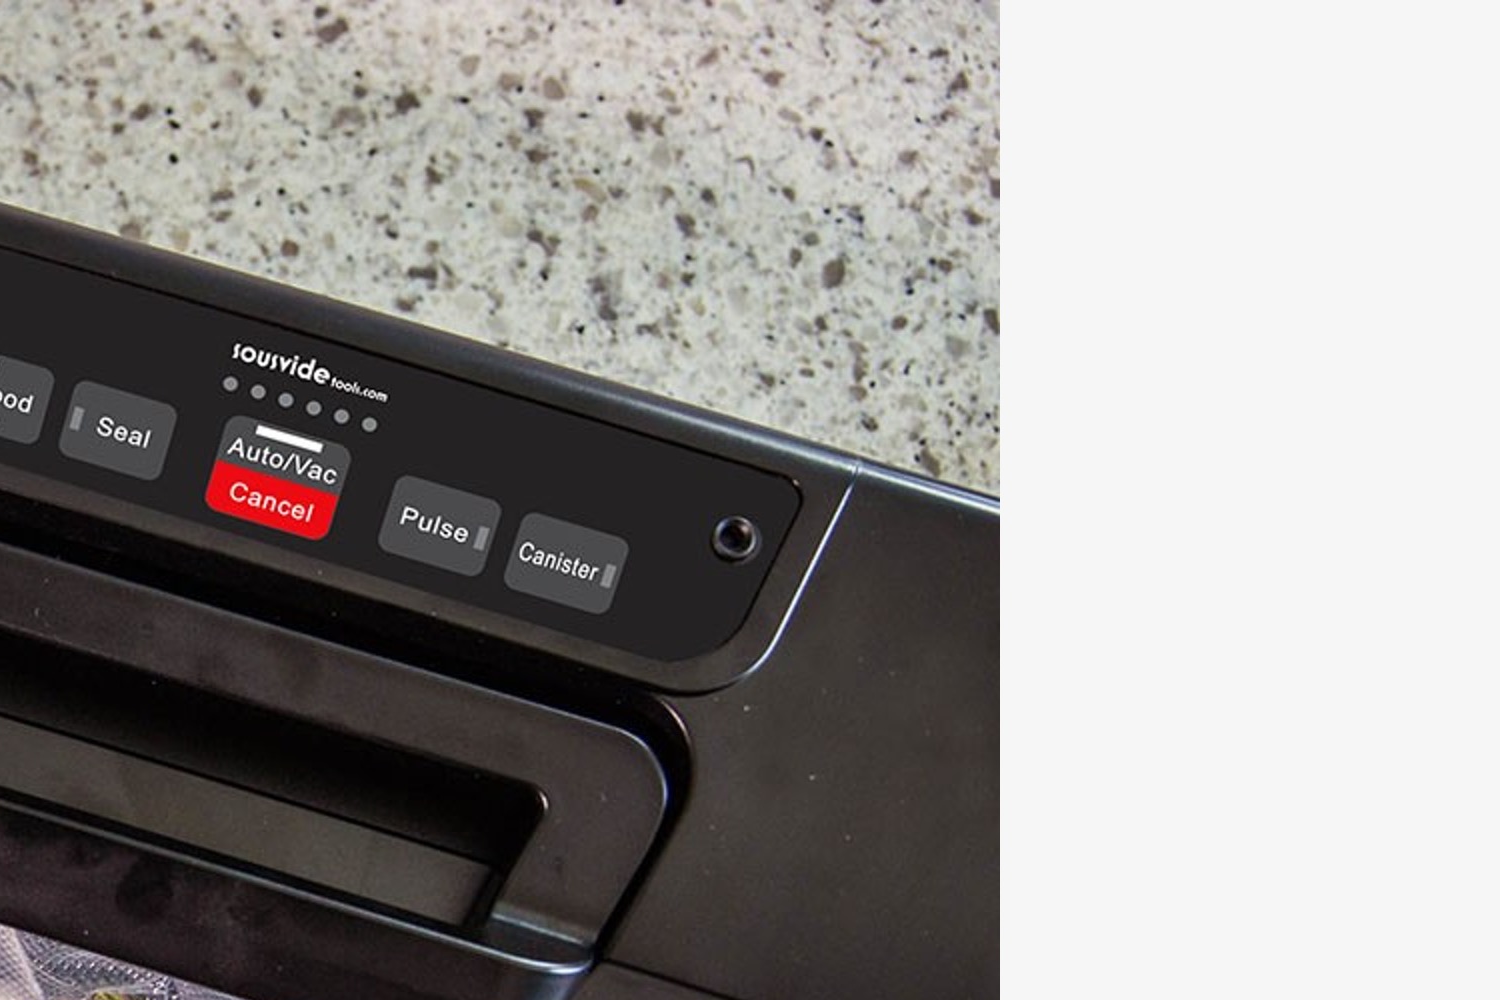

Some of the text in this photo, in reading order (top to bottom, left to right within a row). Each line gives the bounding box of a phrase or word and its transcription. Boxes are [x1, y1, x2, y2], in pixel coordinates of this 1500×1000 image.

[96, 416, 151, 448] Seal
[227, 437, 338, 484] Auto/Vac
[230, 483, 314, 523] Cancel
[400, 506, 469, 543] Pulse
[518, 541, 599, 581] Canister
